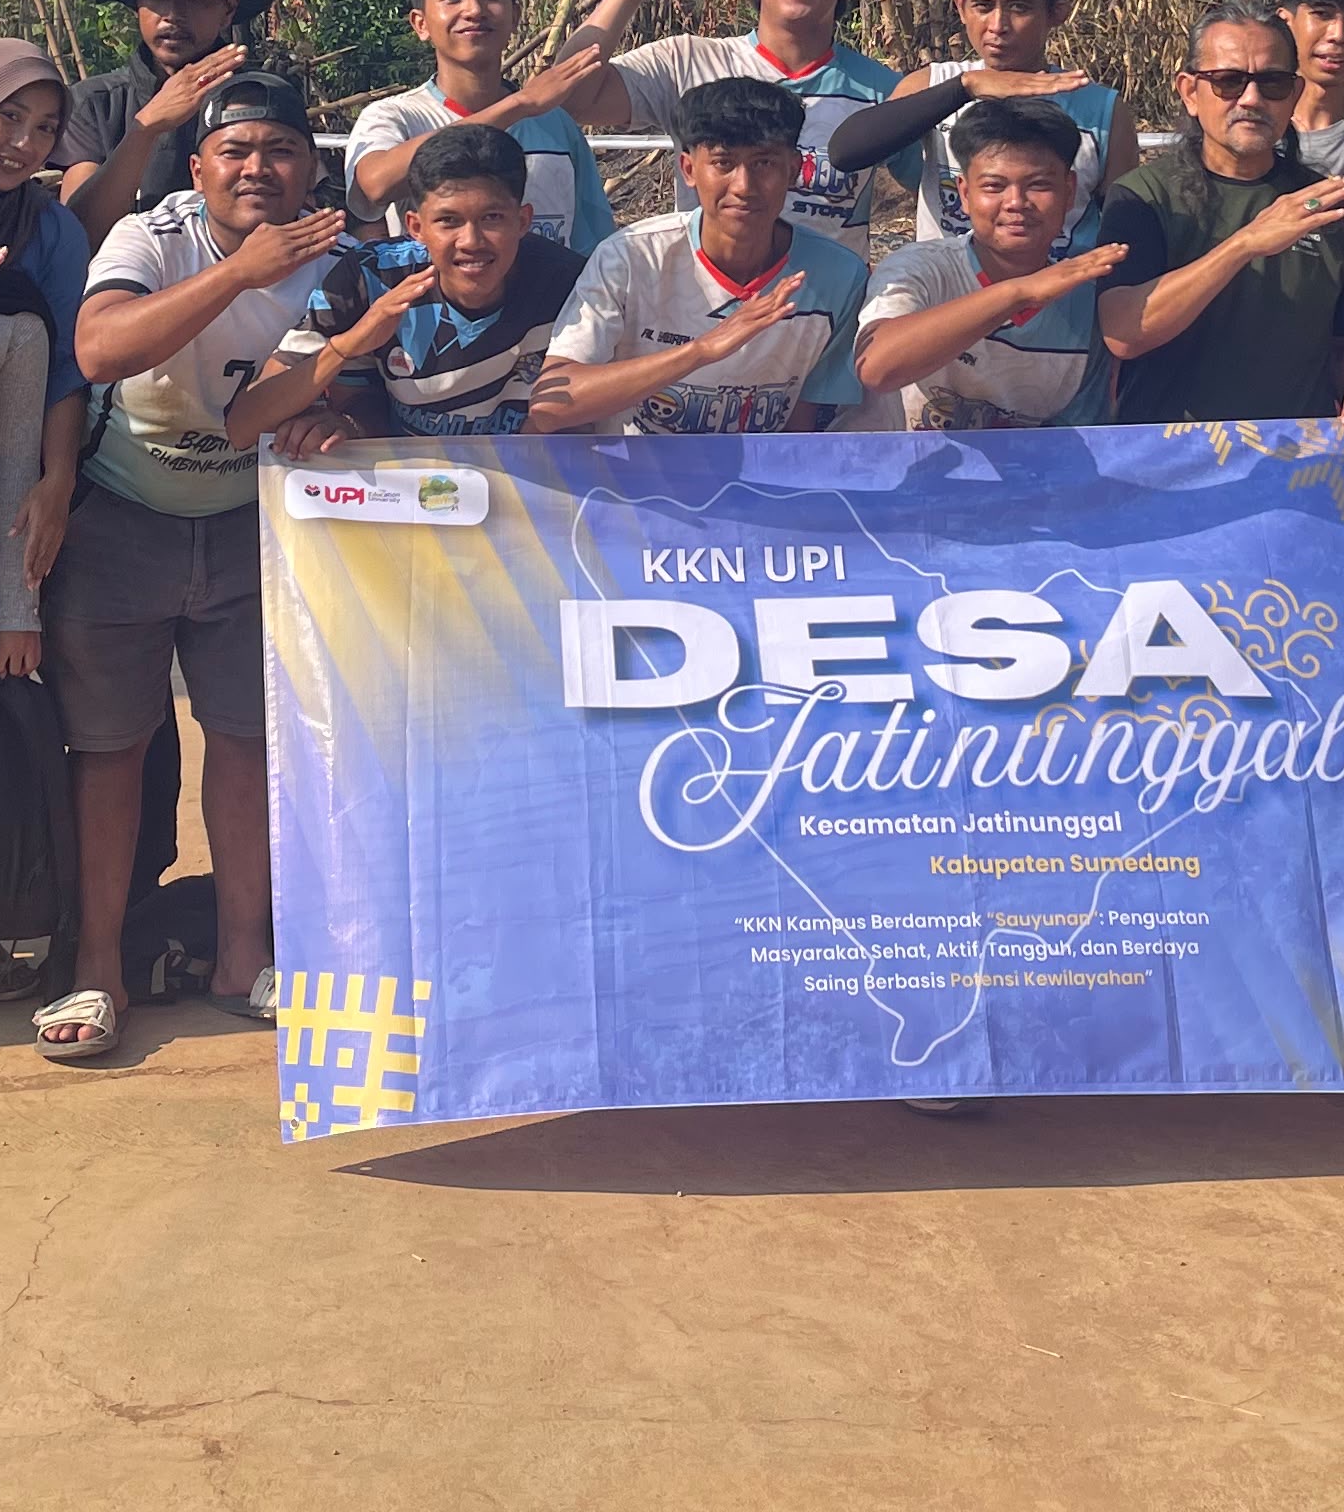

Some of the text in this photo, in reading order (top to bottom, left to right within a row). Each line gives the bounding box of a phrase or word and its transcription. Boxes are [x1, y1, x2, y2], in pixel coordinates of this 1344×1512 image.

[223, 359, 256, 417] 7
[324, 486, 365, 506] UPI
[642, 544, 846, 584] KKN UPI
[560, 580, 1273, 708] DESA
[799, 810, 1123, 839] Kecamatan Jatinunggal
[929, 853, 1200, 880] Kabupaten Sumedang
[787, 916, 867, 935] Kampus
[871, 911, 982, 932] Berdampak
[1108, 910, 1210, 930] Penguatan
[751, 939, 1199, 966] Masyarakat Sehat, Aktif, Tangguh, dan Berdaya
[804, 974, 859, 995] Saing
[864, 972, 946, 990] Berbasis
[950, 970, 1020, 988] Potensi
